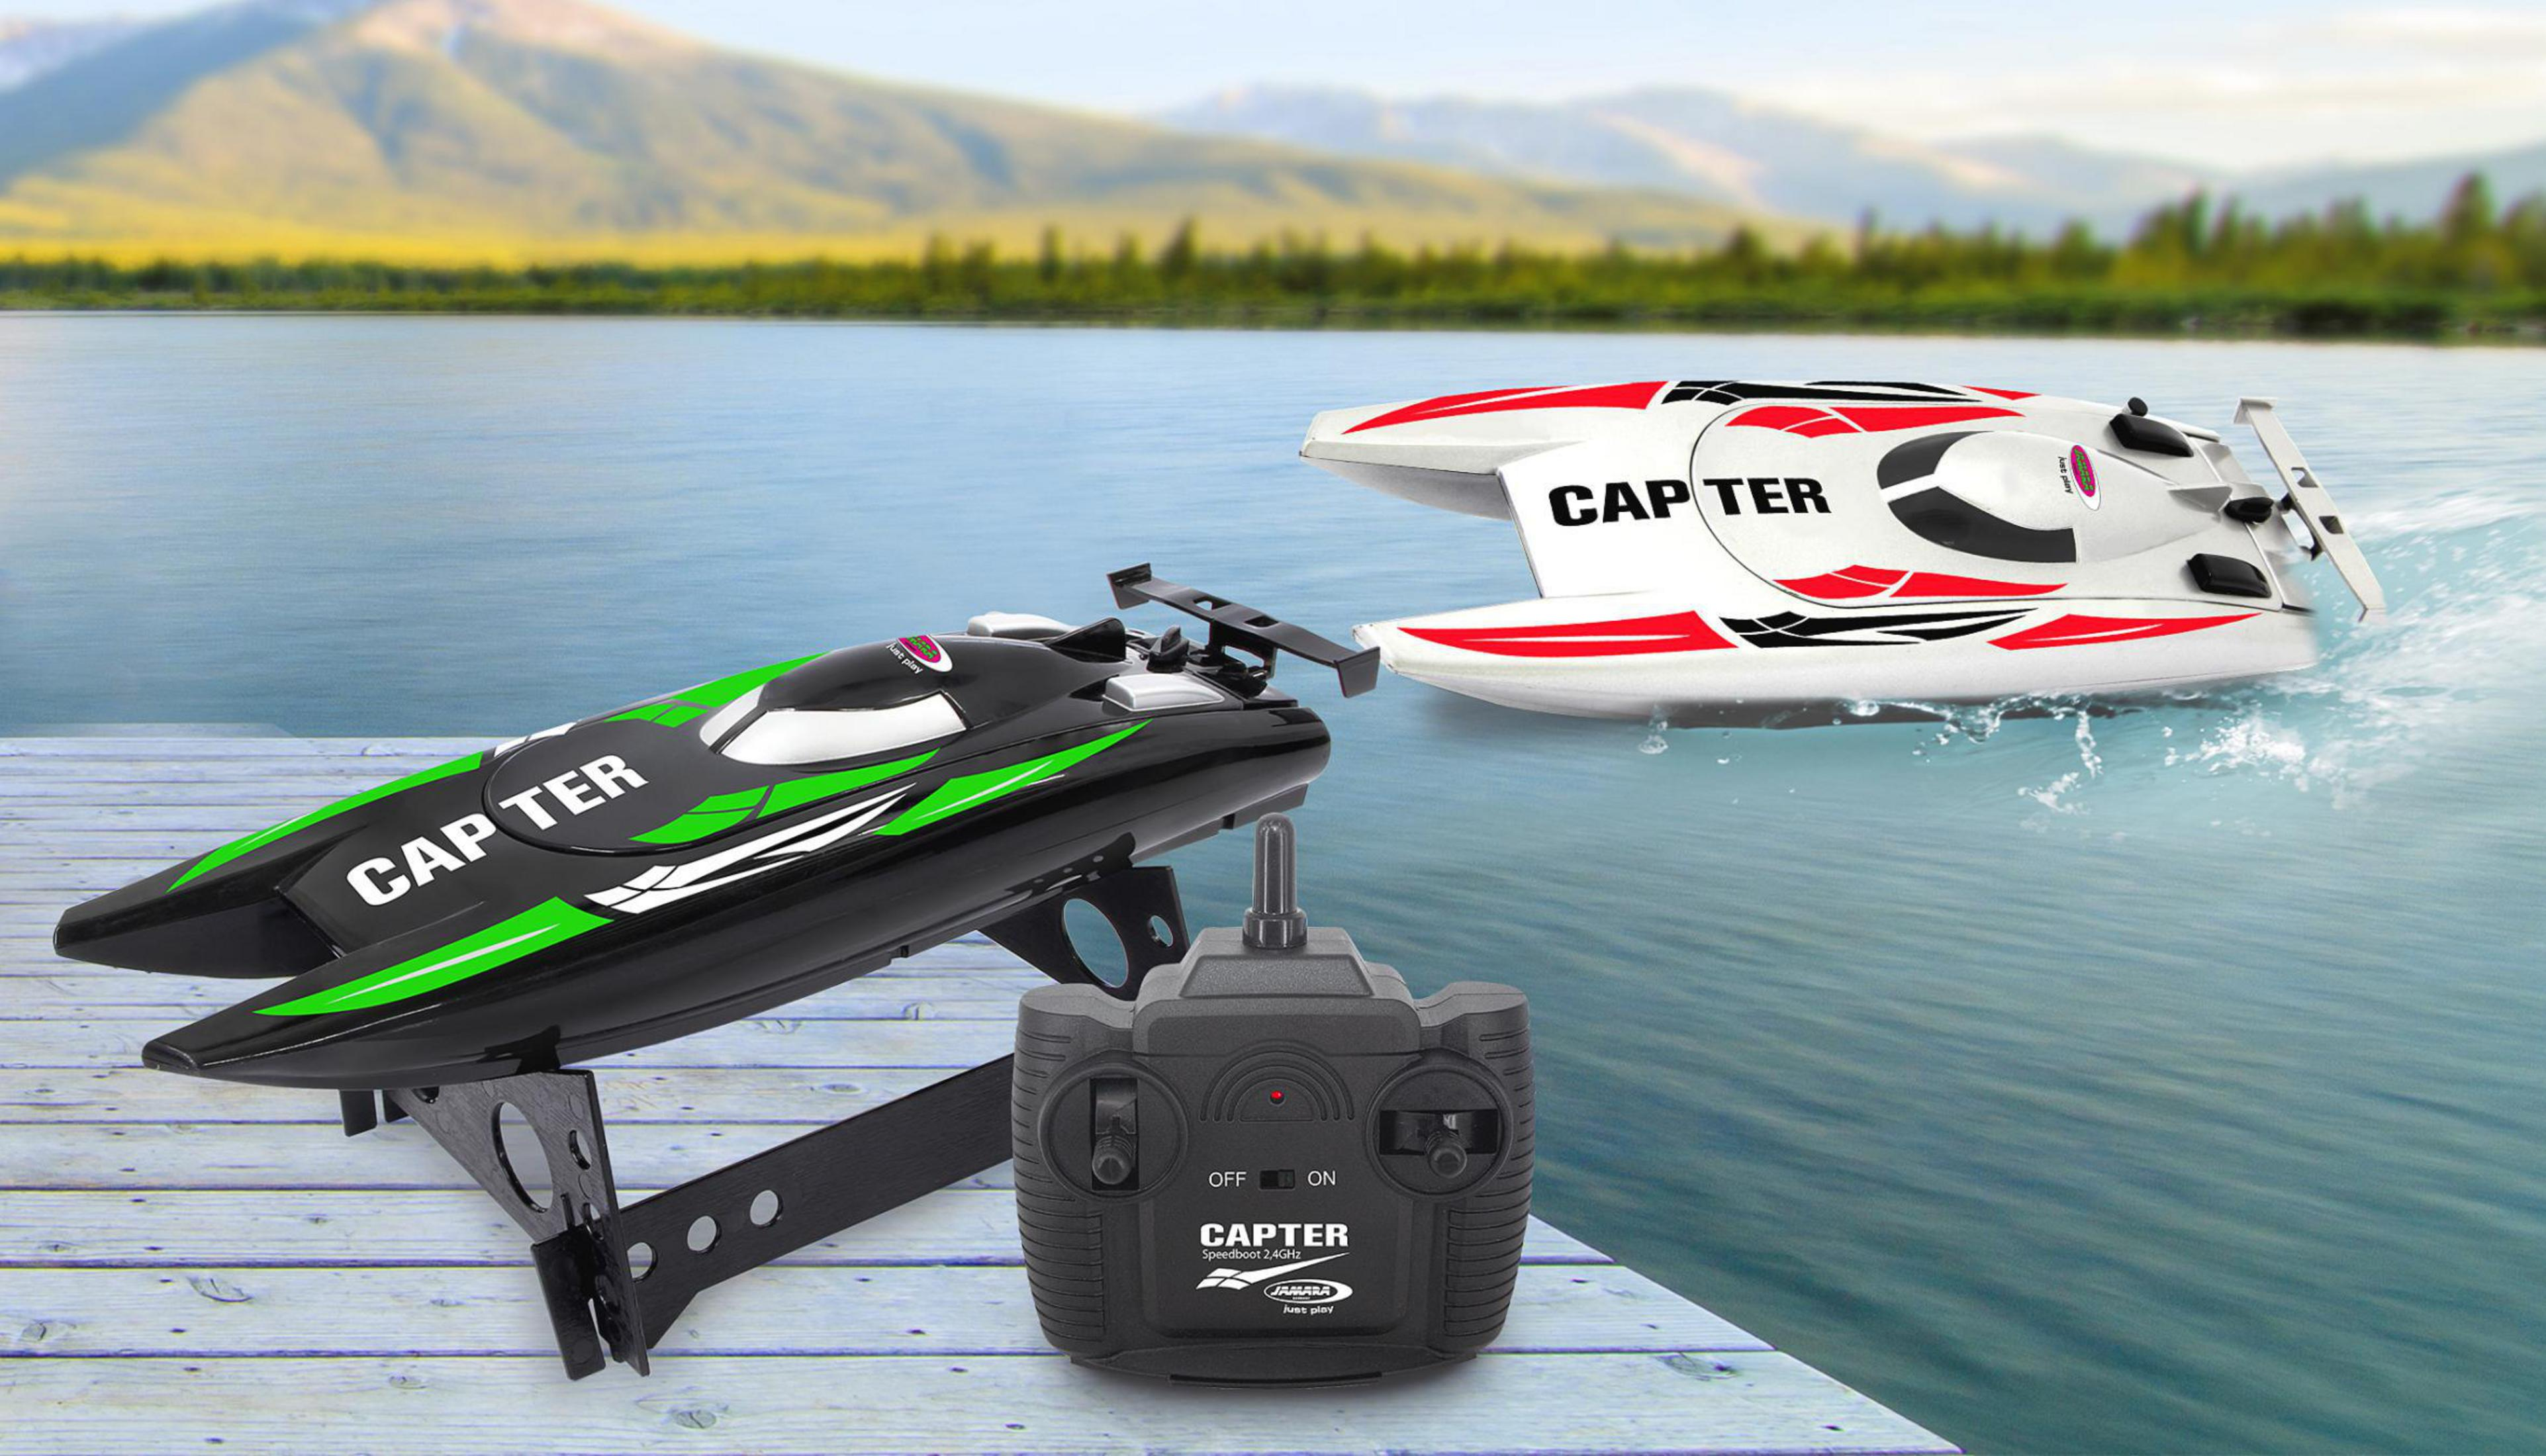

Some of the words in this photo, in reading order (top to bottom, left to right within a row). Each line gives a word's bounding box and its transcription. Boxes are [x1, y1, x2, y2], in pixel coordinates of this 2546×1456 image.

[1208, 1171, 1247, 1187] OFF
[1307, 1170, 1336, 1187] ON
[1200, 1223, 1349, 1247] CAPTER
[1202, 1248, 1260, 1261] Speedboot
[1263, 1248, 1301, 1261] 2,4GHz
[1270, 1285, 1331, 1296] JAMARA
[1283, 1304, 1307, 1314] just
[1310, 1305, 1334, 1316] play
